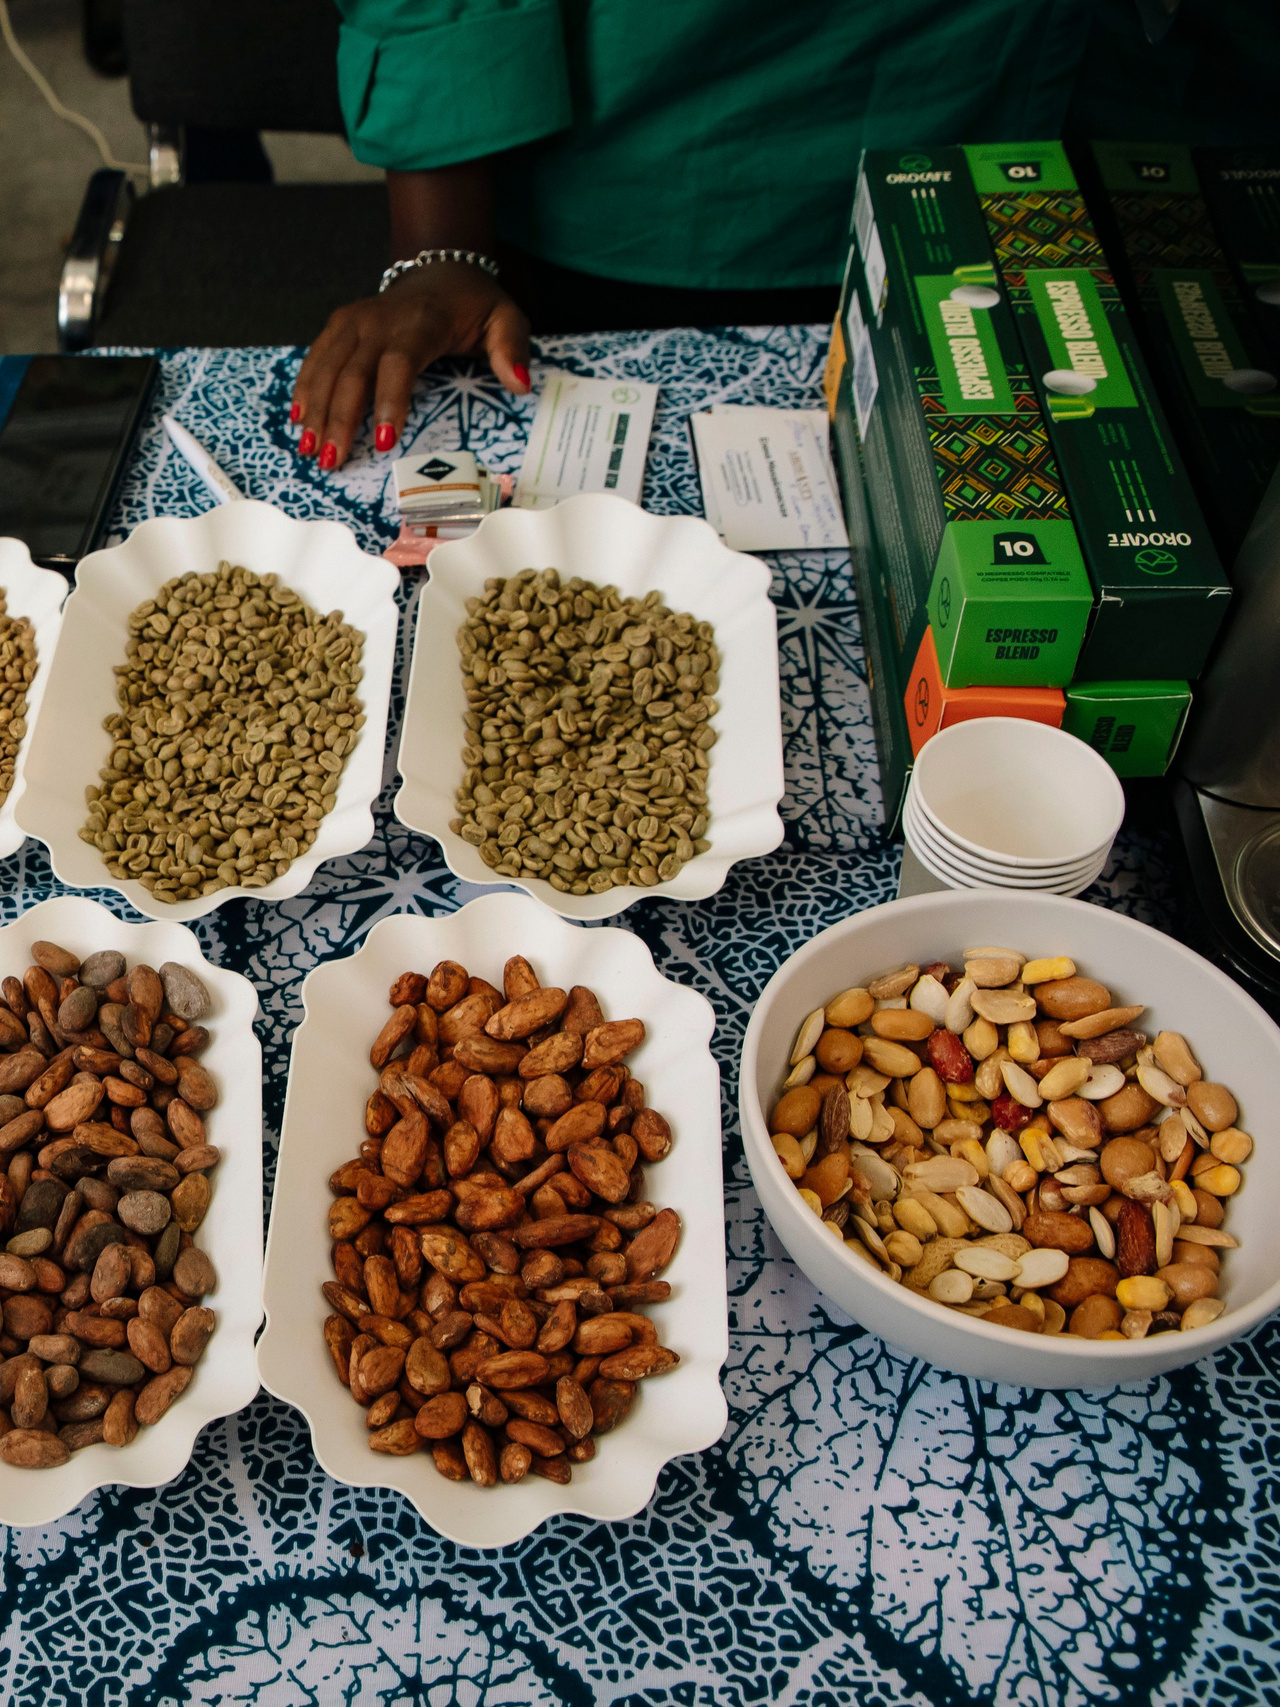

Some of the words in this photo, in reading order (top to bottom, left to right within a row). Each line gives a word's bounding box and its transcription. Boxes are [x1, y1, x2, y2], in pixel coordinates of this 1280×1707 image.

[1045, 280, 1094, 339] ESPRESSO
[948, 338, 995, 400] ESPRESSO
[999, 541, 1034, 557] 10
[985, 628, 1058, 643] ESPRESSO
[995, 645, 1040, 660] BLEND
